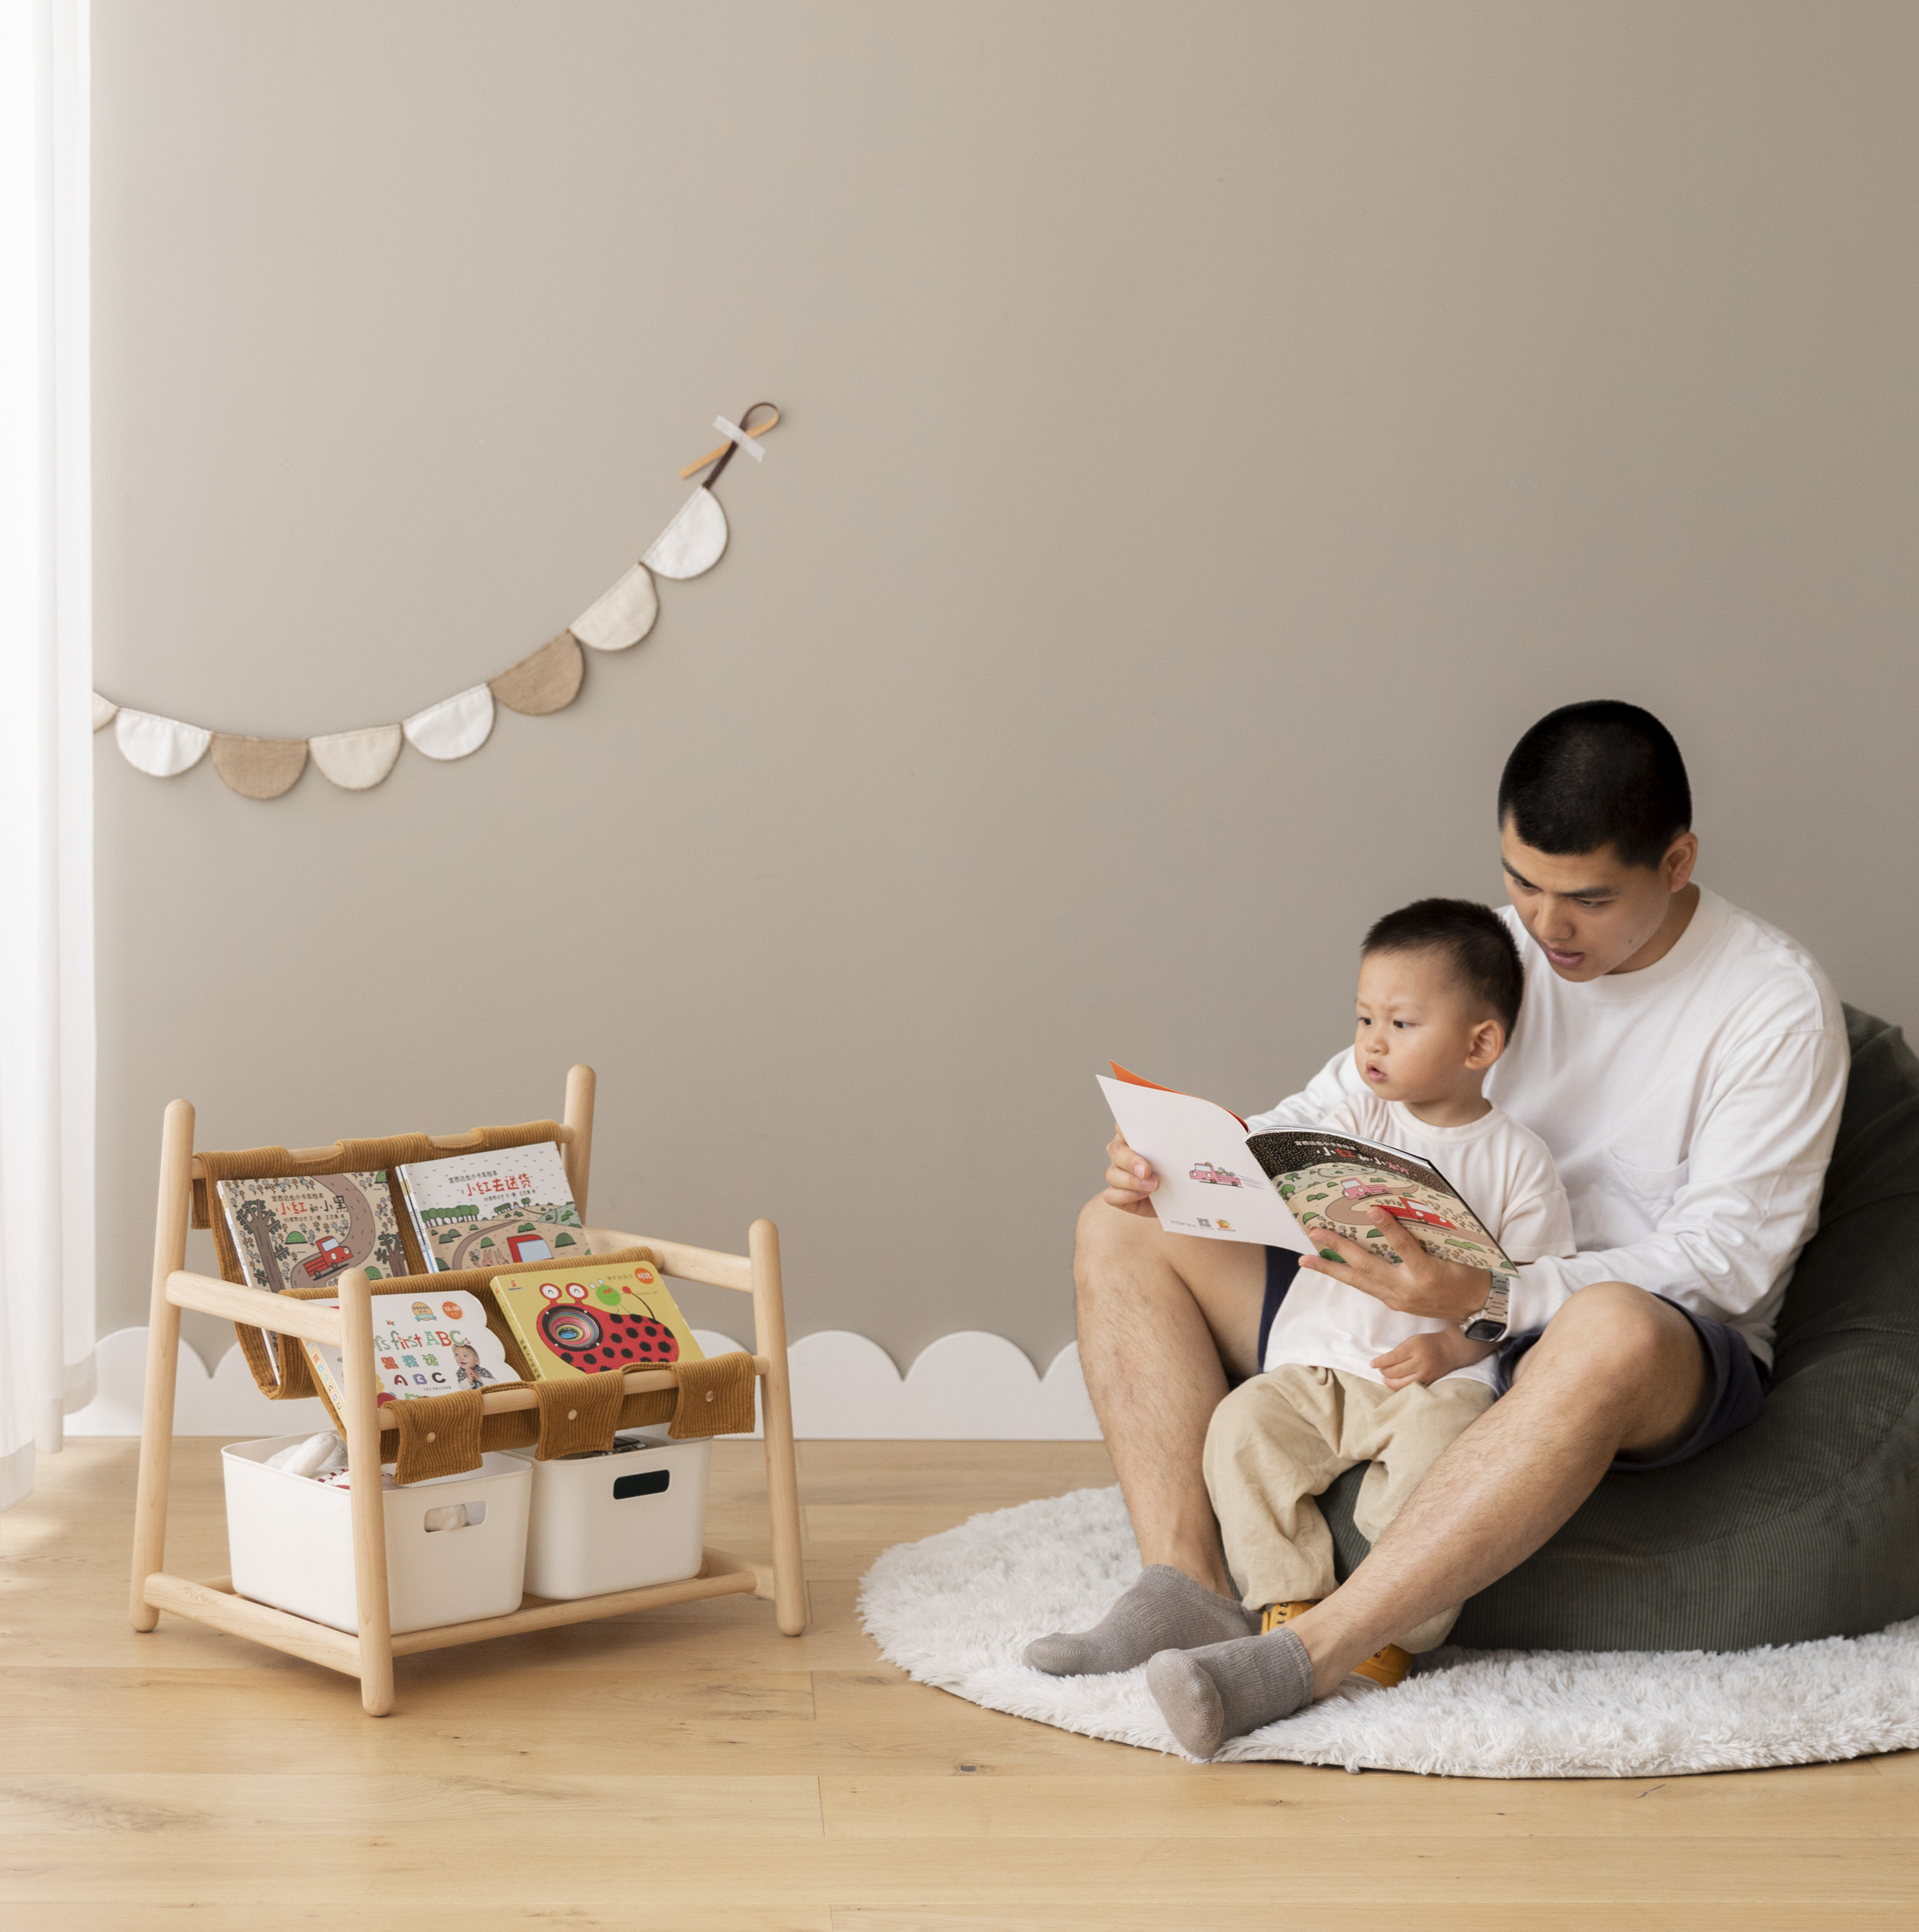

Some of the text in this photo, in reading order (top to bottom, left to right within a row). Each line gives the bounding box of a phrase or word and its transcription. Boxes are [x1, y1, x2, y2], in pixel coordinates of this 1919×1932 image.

[448, 1170, 498, 1184] 宫西达也小卡车绘本
[461, 1173, 532, 1197] 小红去送货
[271, 1193, 325, 1202] 宫西达也小卡车绘本
[275, 1195, 346, 1215] 小红和小黑
[390, 1330, 422, 1350] first
[424, 1330, 471, 1347] ABCs
